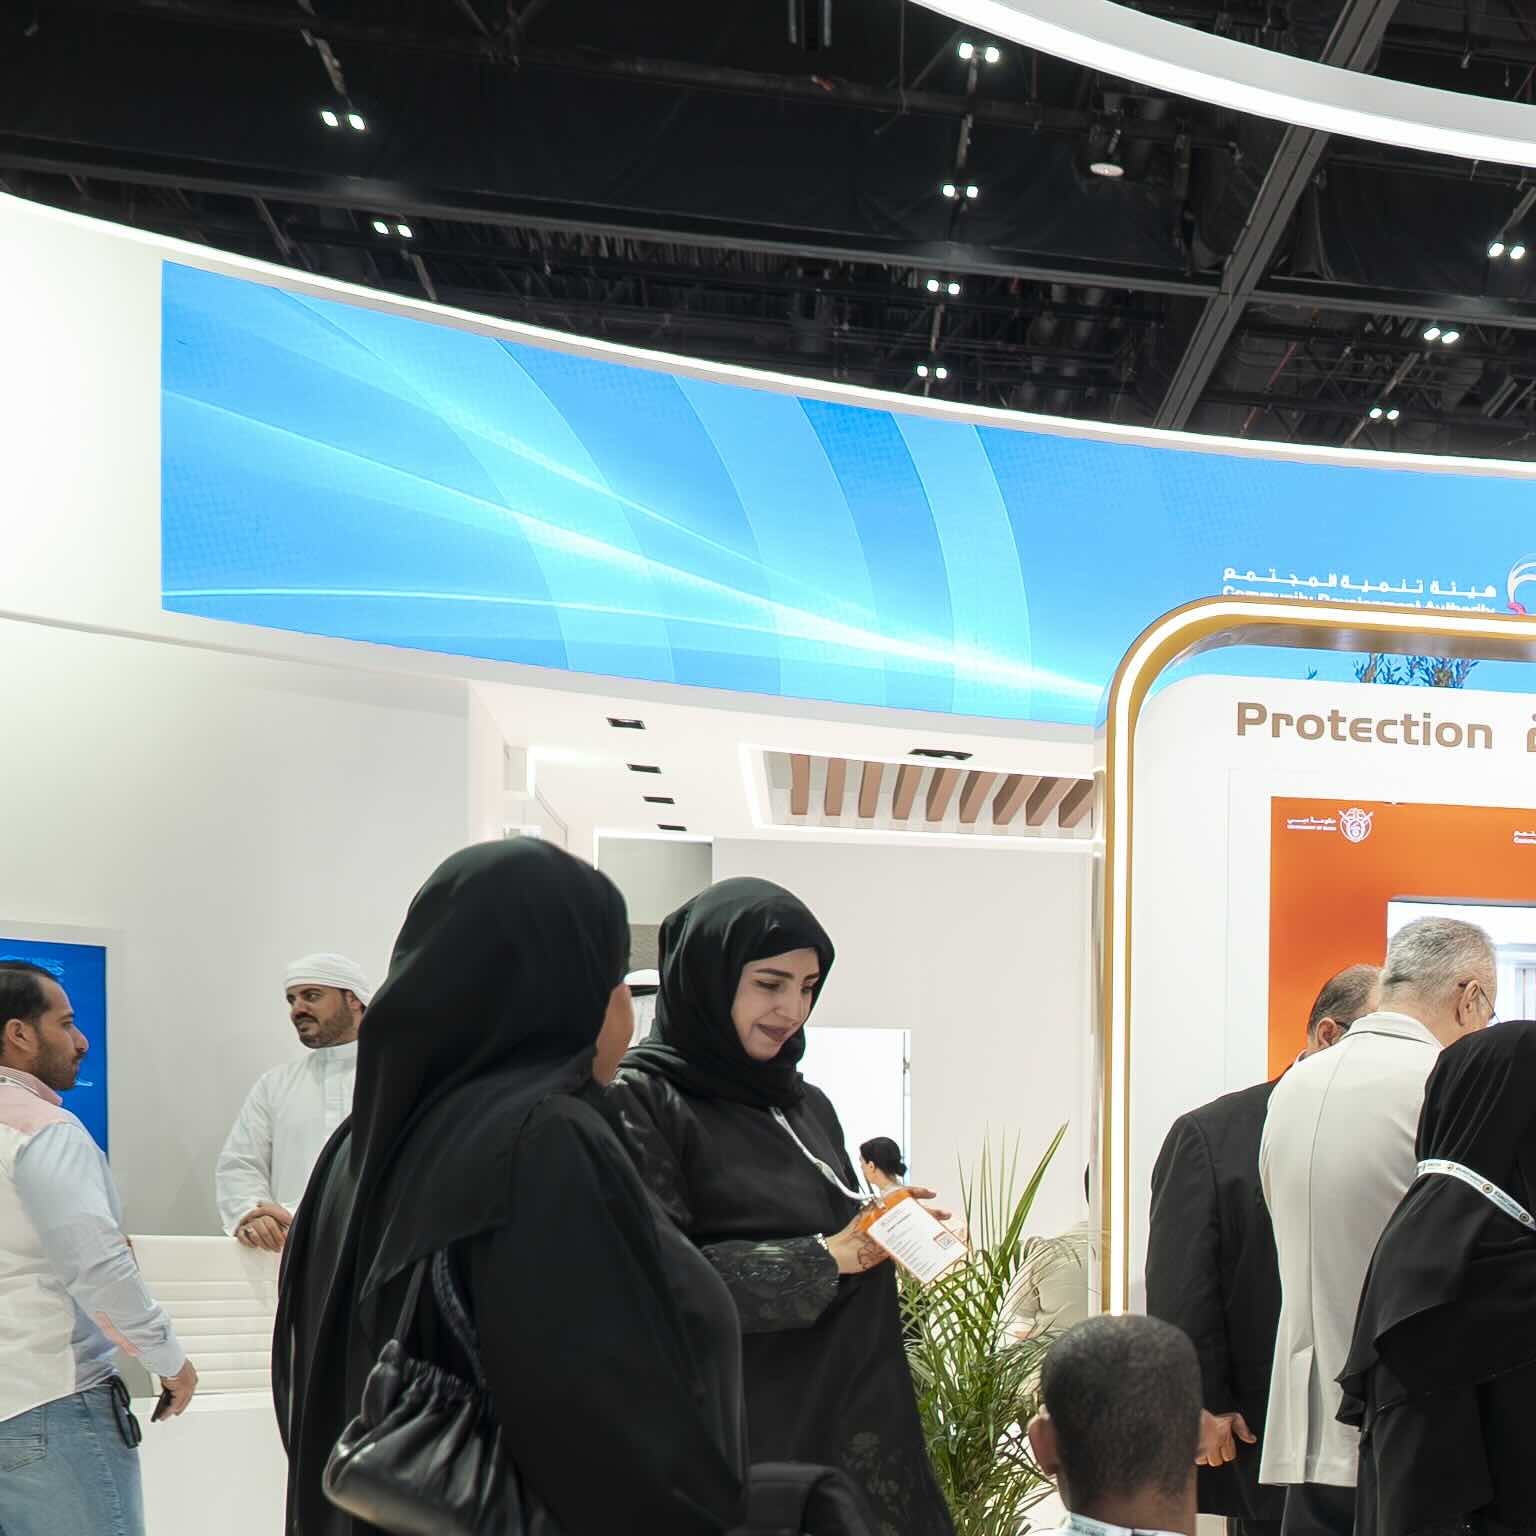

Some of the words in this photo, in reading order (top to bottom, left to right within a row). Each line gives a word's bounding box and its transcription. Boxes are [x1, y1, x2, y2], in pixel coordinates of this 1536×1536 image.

[1223, 567, 1338, 588] المجتمع
[1341, 574, 1424, 594] تنمية
[1431, 579, 1497, 599] هيئة
[1237, 701, 1493, 750] Protection
